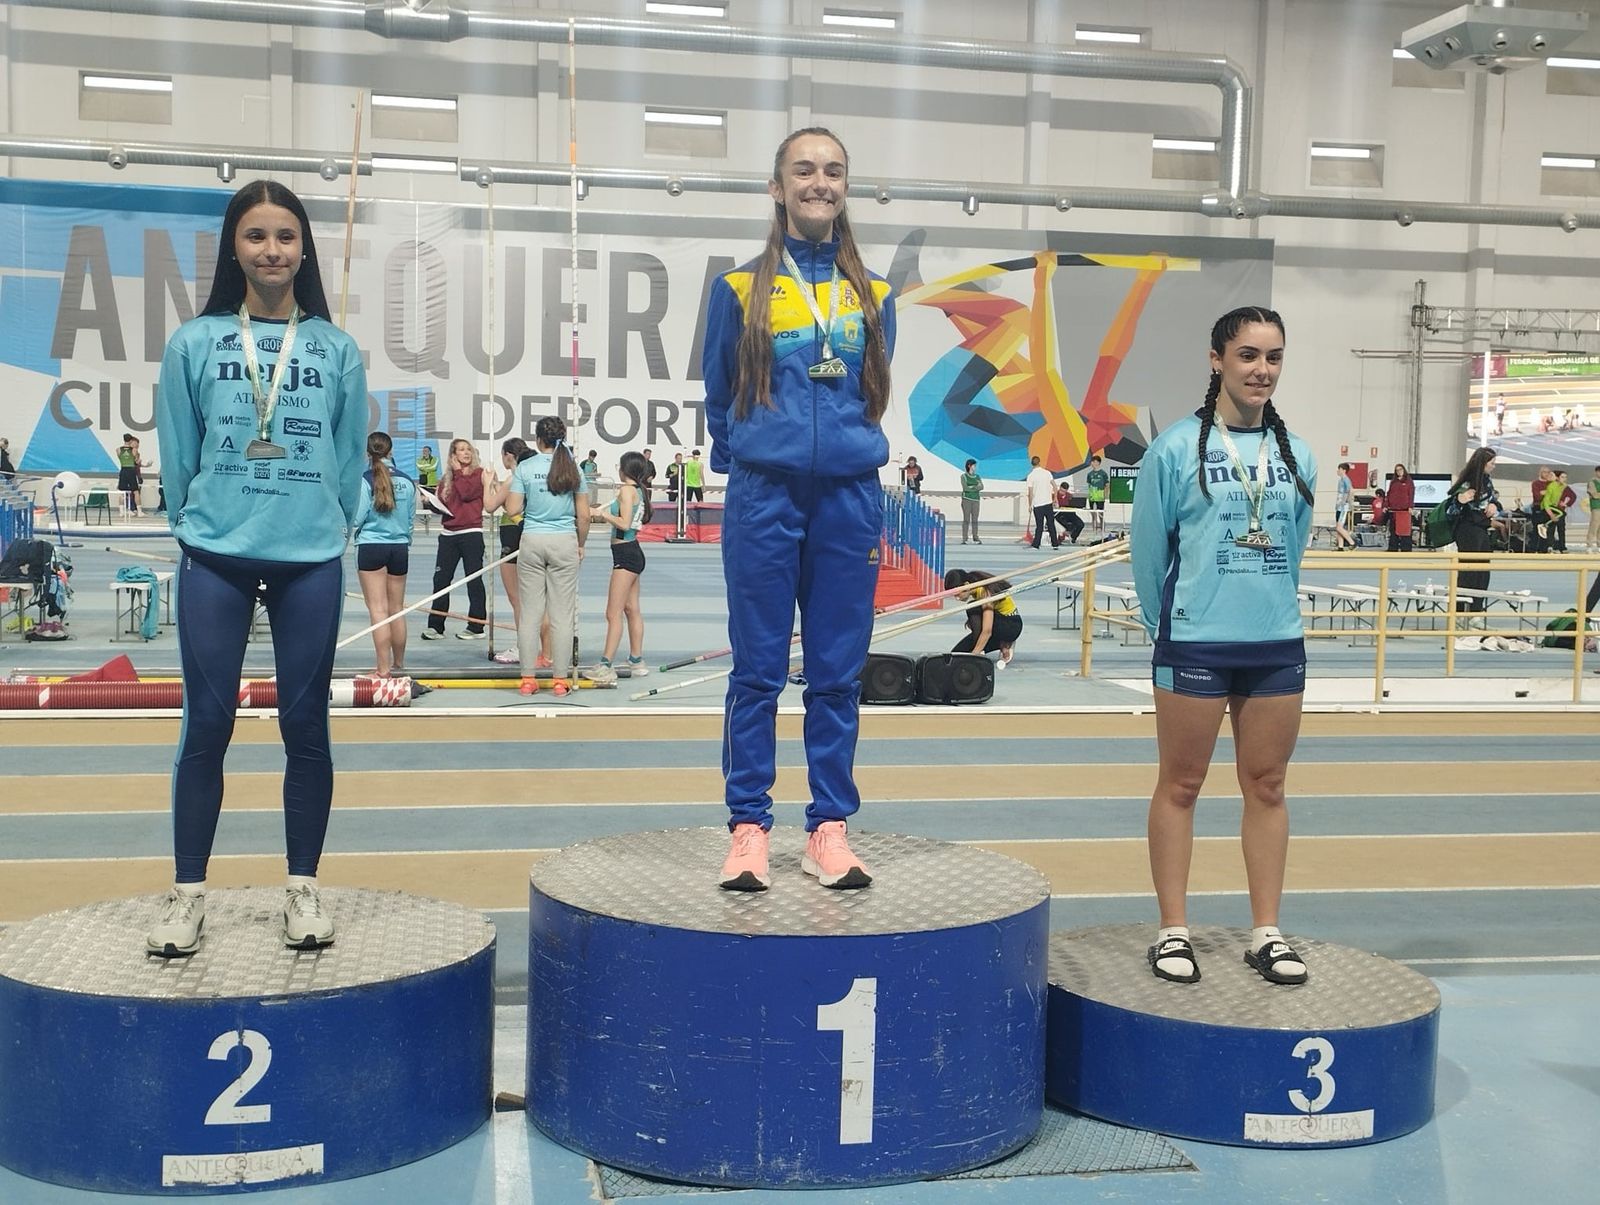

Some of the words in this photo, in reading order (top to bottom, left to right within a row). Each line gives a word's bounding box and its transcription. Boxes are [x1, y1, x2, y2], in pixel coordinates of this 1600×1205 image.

[50, 224, 736, 381] ANEQUER
[259, 339, 284, 352] TROP
[773, 331, 800, 340] VOS
[471, 393, 706, 447] DEPORT
[1205, 451, 1229, 462] ROPS
[1126, 479, 1134, 491] 1
[1164, 941, 1186, 949] NIKE
[203, 1028, 272, 1126] 2
[817, 978, 877, 1145] 1
[1287, 1036, 1336, 1113] 3
